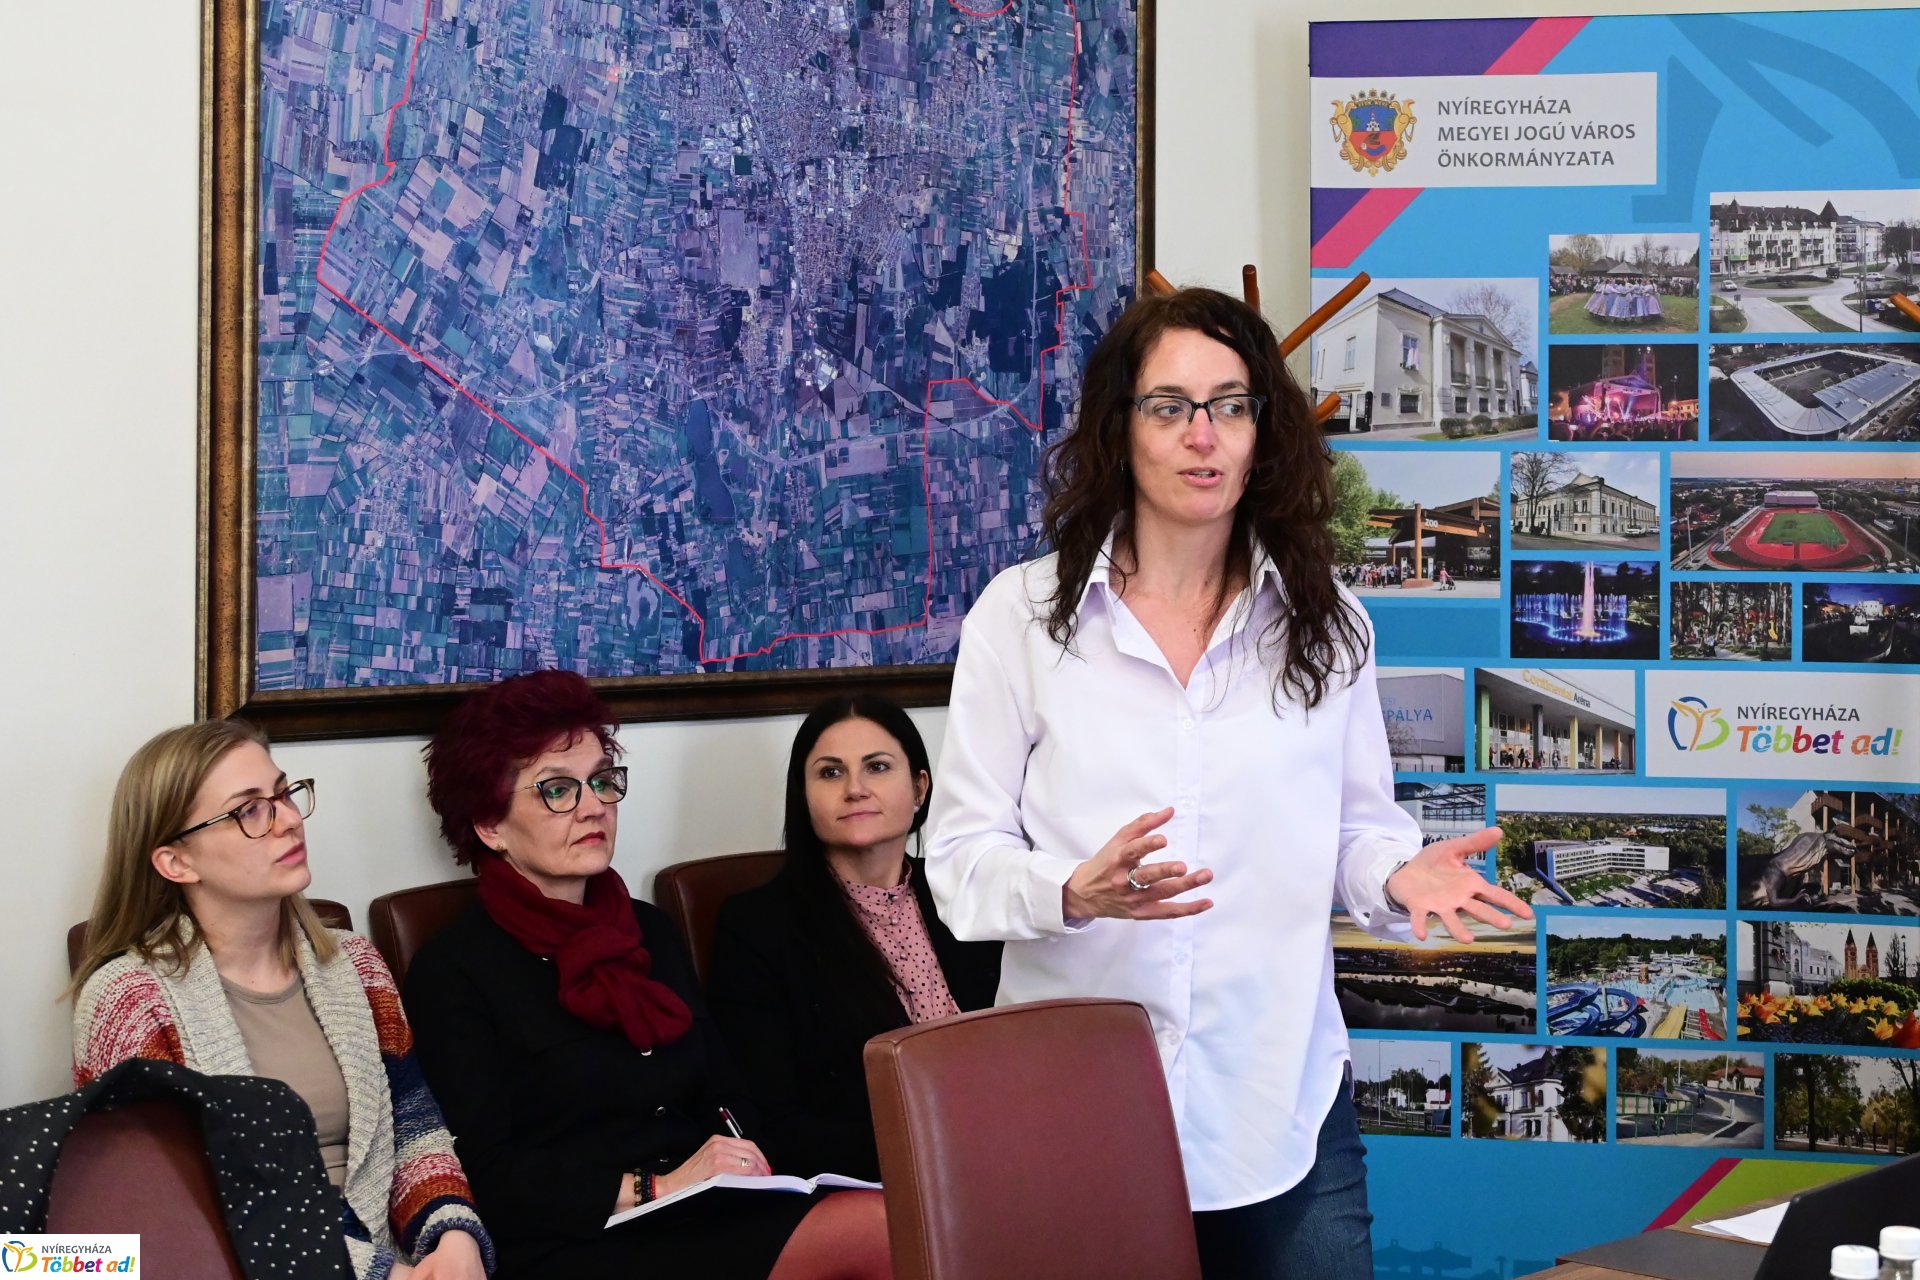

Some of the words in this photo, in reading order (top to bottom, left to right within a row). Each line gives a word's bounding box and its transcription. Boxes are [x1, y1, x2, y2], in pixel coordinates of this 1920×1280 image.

[1438, 96, 1571, 116] NYÍREGYHÁZA
[1438, 126, 1509, 142] MEGYEI
[1515, 122, 1566, 141] JOGÚ
[1571, 121, 1636, 140] VÁROS
[1438, 148, 1615, 168] ÖNKORMÁNYZATA
[1737, 703, 1861, 722] NYÍREGYHÁZA
[1736, 724, 1845, 754] Többet
[1850, 727, 1904, 756] ad!
